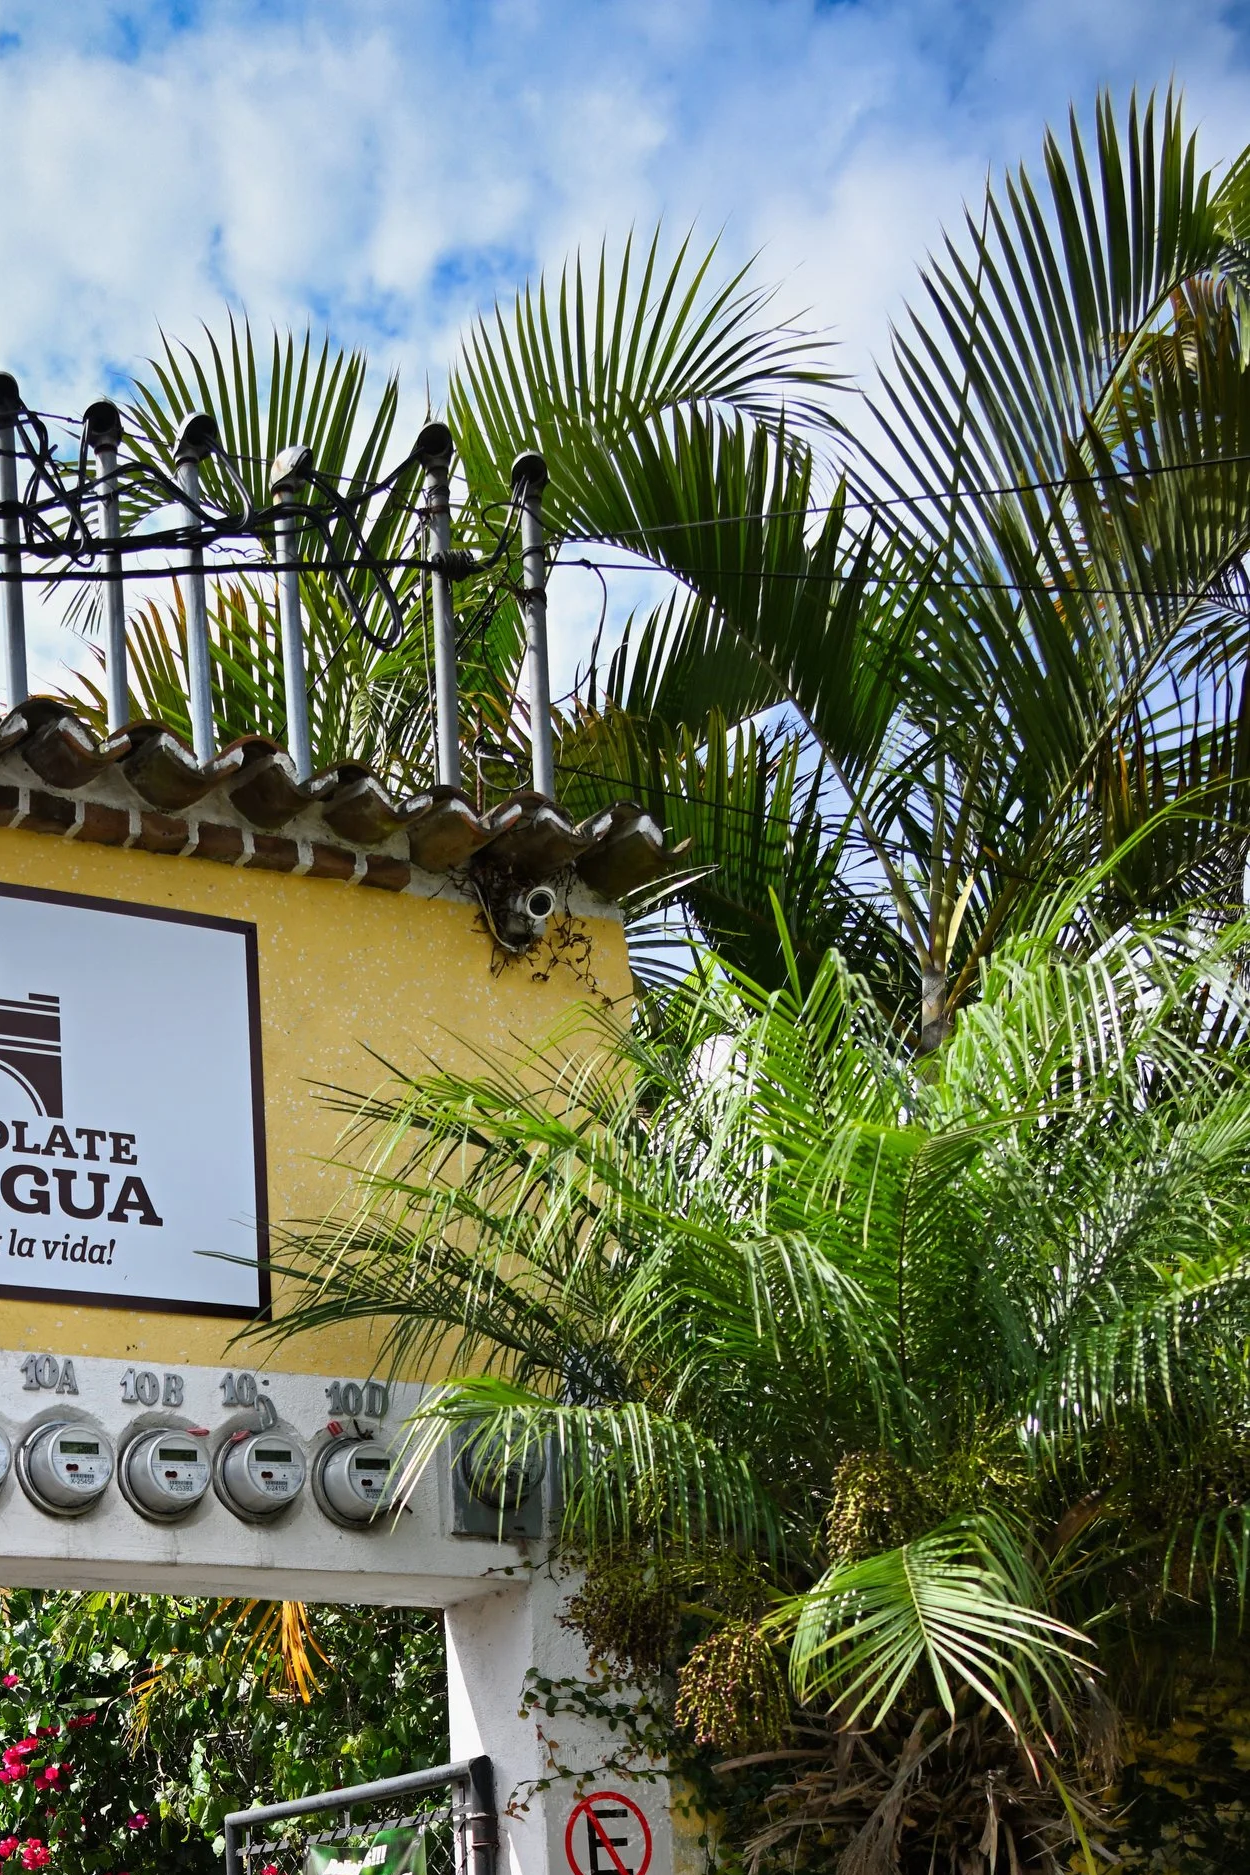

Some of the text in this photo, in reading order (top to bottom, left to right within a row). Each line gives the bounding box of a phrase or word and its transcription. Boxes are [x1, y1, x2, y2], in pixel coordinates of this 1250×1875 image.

[8, 1229, 34, 1258] la
[42, 1234, 116, 1265] vida!
[20, 1354, 79, 1395] 10A
[326, 1381, 390, 1418] 10D
